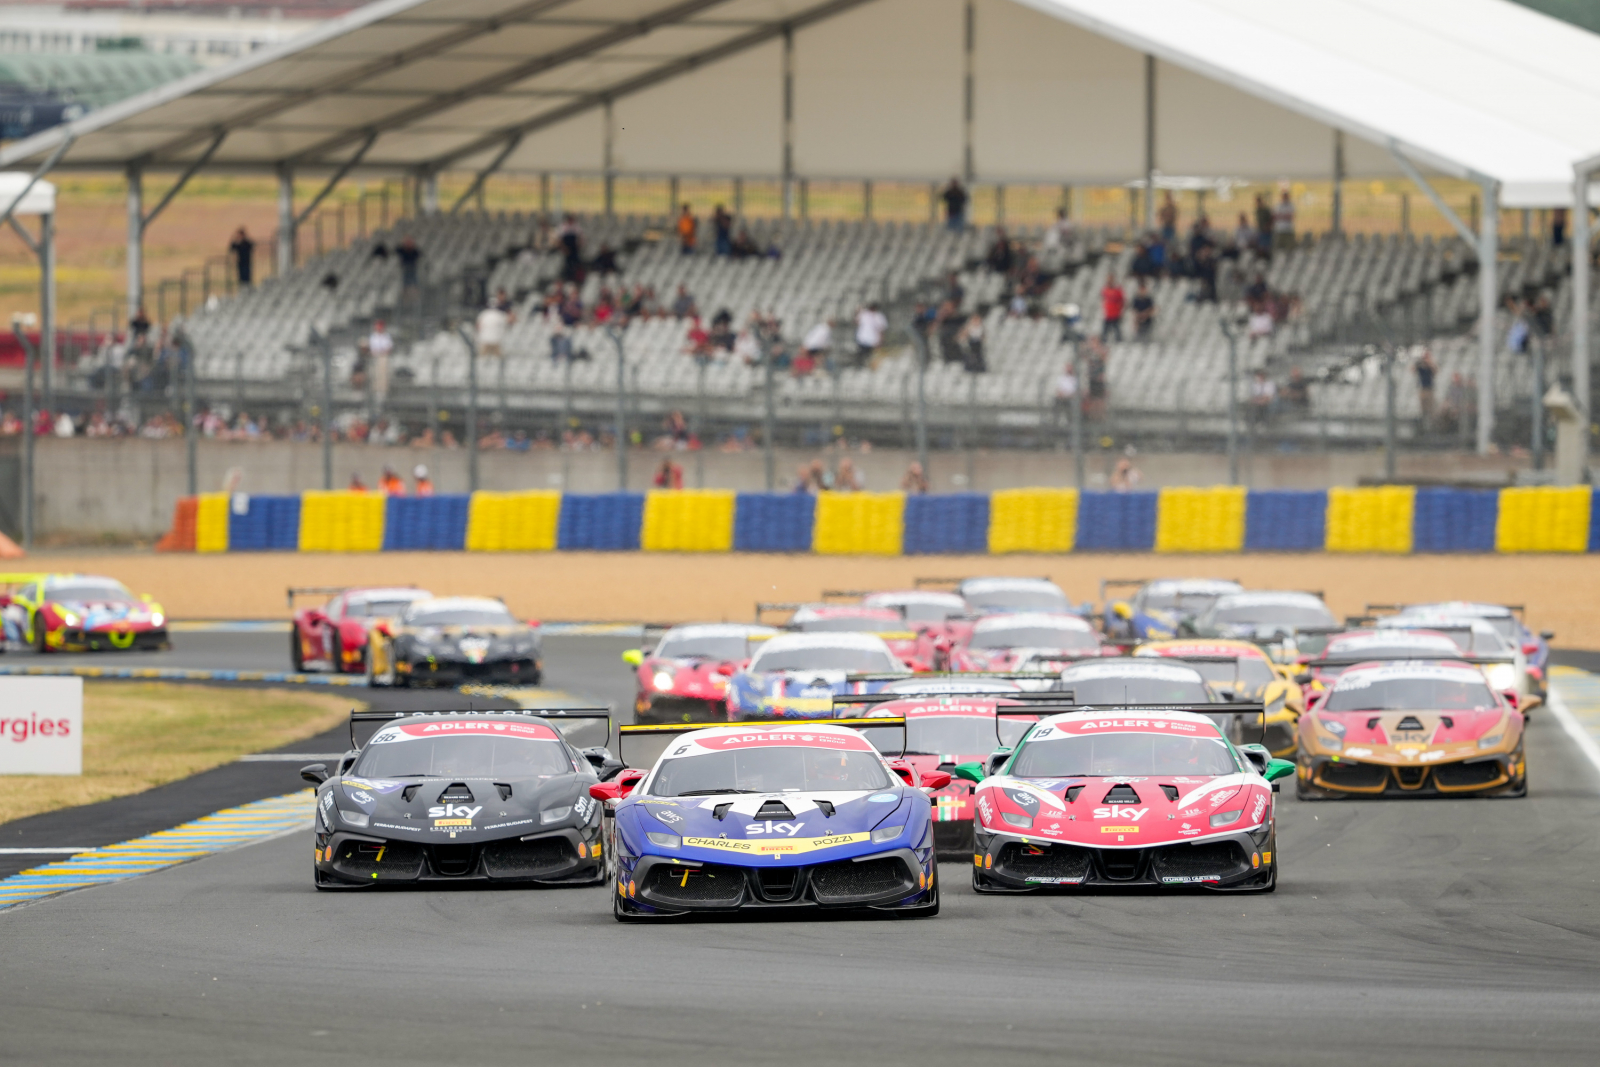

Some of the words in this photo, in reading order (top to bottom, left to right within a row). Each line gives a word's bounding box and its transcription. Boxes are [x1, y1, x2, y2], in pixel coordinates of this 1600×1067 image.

[910, 705, 972, 714] ADLER
[0, 711, 71, 742] rgies
[423, 722, 490, 732] ADLER
[1080, 720, 1149, 730] ADLER
[722, 733, 795, 745] ADLER
[1032, 727, 1054, 739] 19
[673, 744, 691, 756] 6
[428, 803, 483, 819] sky
[1093, 804, 1150, 821] sky
[745, 820, 806, 837] sky
[688, 837, 752, 850] CHARLES
[813, 835, 853, 847] POZZI
